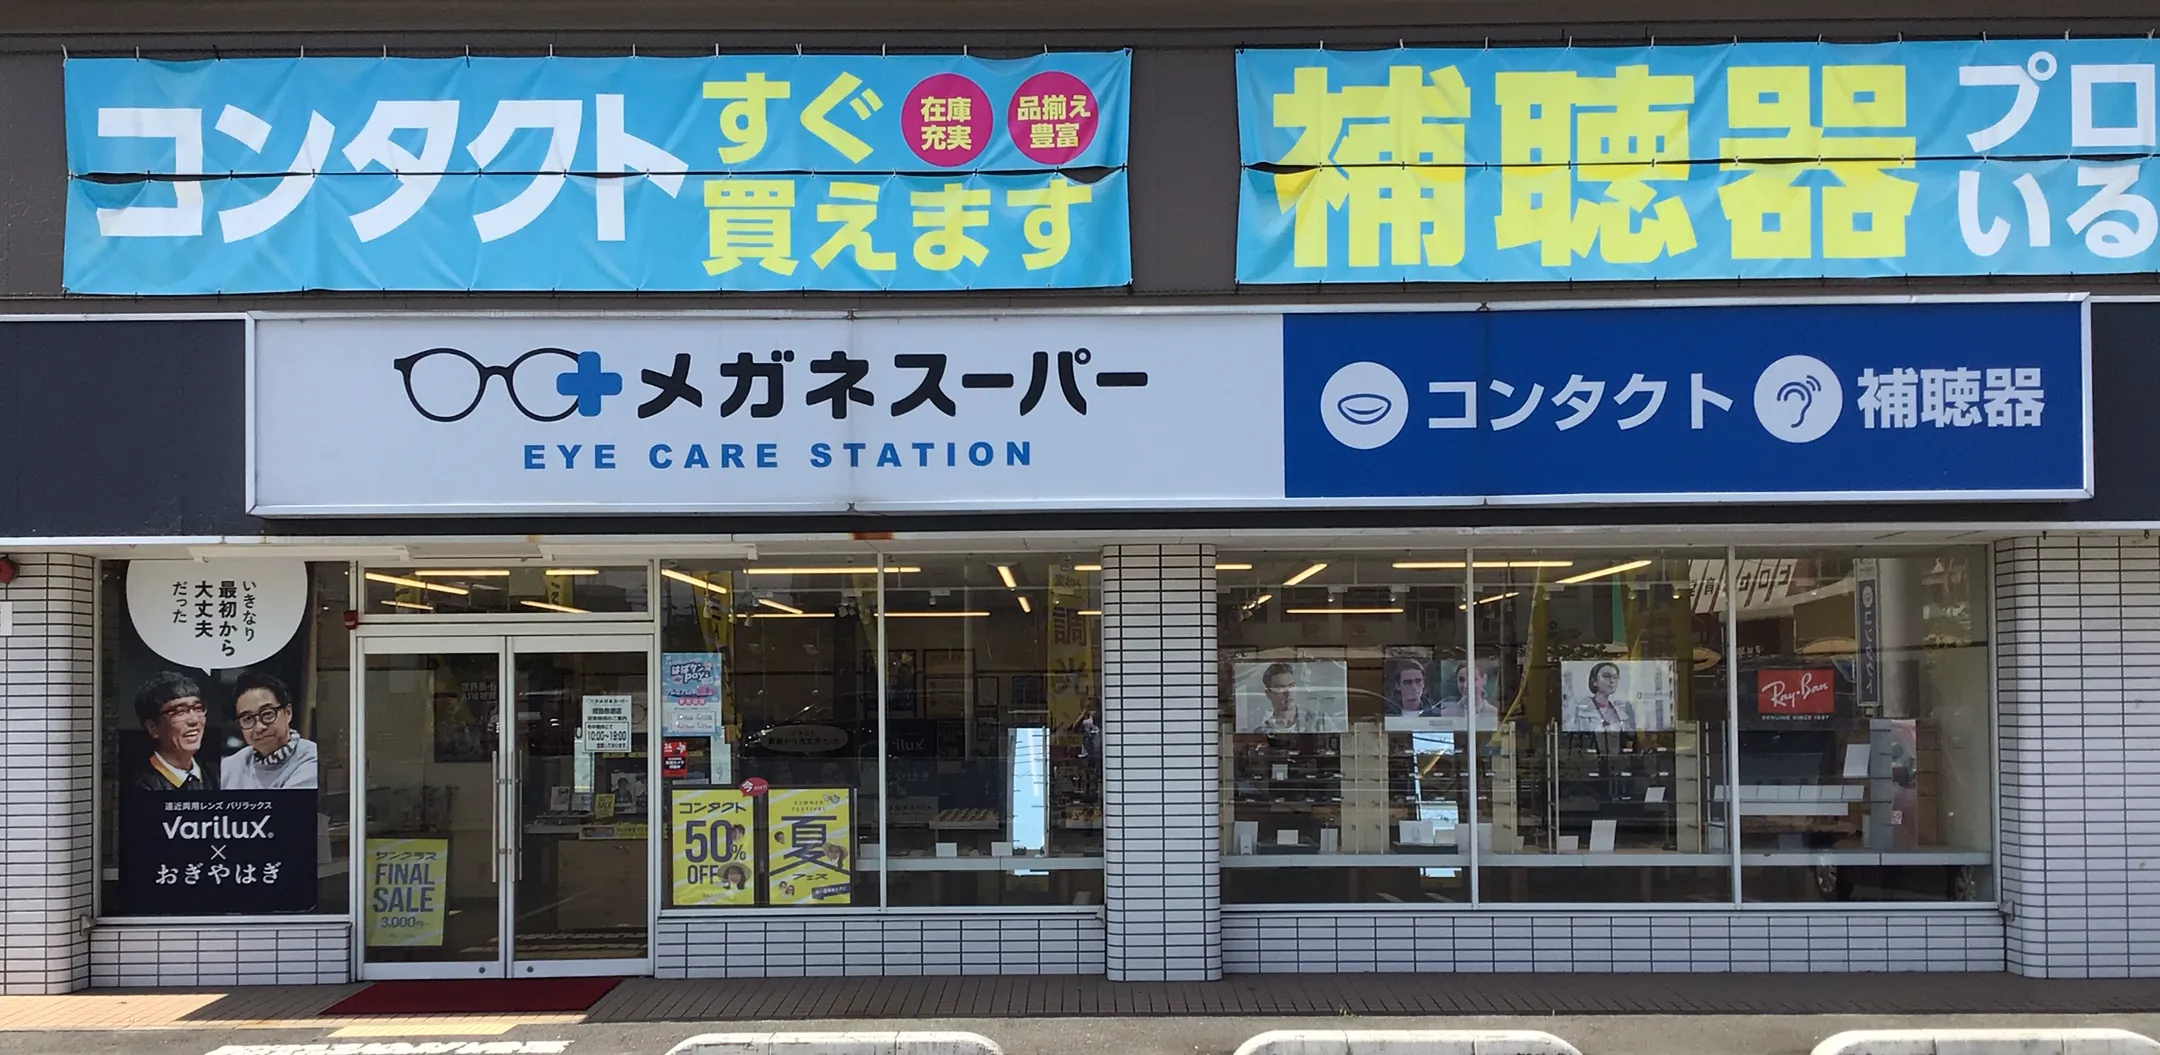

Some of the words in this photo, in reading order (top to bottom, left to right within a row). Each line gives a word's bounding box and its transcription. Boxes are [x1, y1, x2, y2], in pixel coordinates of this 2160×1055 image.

[703, 71, 884, 164] すぐ
[920, 97, 972, 122] 在庫
[1017, 95, 1091, 121] 品揃え
[1958, 51, 2156, 153] プロ
[921, 125, 972, 150] 充実
[1030, 123, 1080, 148] 豊富
[98, 94, 689, 243] コンタクト
[1273, 64, 1919, 268] 補聴器
[703, 179, 1093, 276] 買えます
[1958, 164, 2159, 259] いる
[637, 347, 1149, 419] メガネスーパー
[1428, 372, 1734, 430] コンタクト
[1857, 367, 2045, 428] 補聴器
[524, 444, 616, 469] EYE
[649, 443, 778, 468] CARE
[810, 442, 1030, 468] STATION
[172, 581, 188, 623] だった
[194, 580, 214, 638] 大丈夫
[218, 580, 238, 657] 最初から
[242, 581, 257, 642] いきなり
[226, 801, 272, 811] バリラックス
[679, 802, 746, 814] コンタクト
[376, 851, 437, 861] サングラス
[685, 820, 747, 863] 50%
[769, 815, 851, 876] 夏
[155, 862, 282, 885] おぎやはぎ
[375, 863, 436, 885] FINAL
[372, 887, 436, 913] SALE
